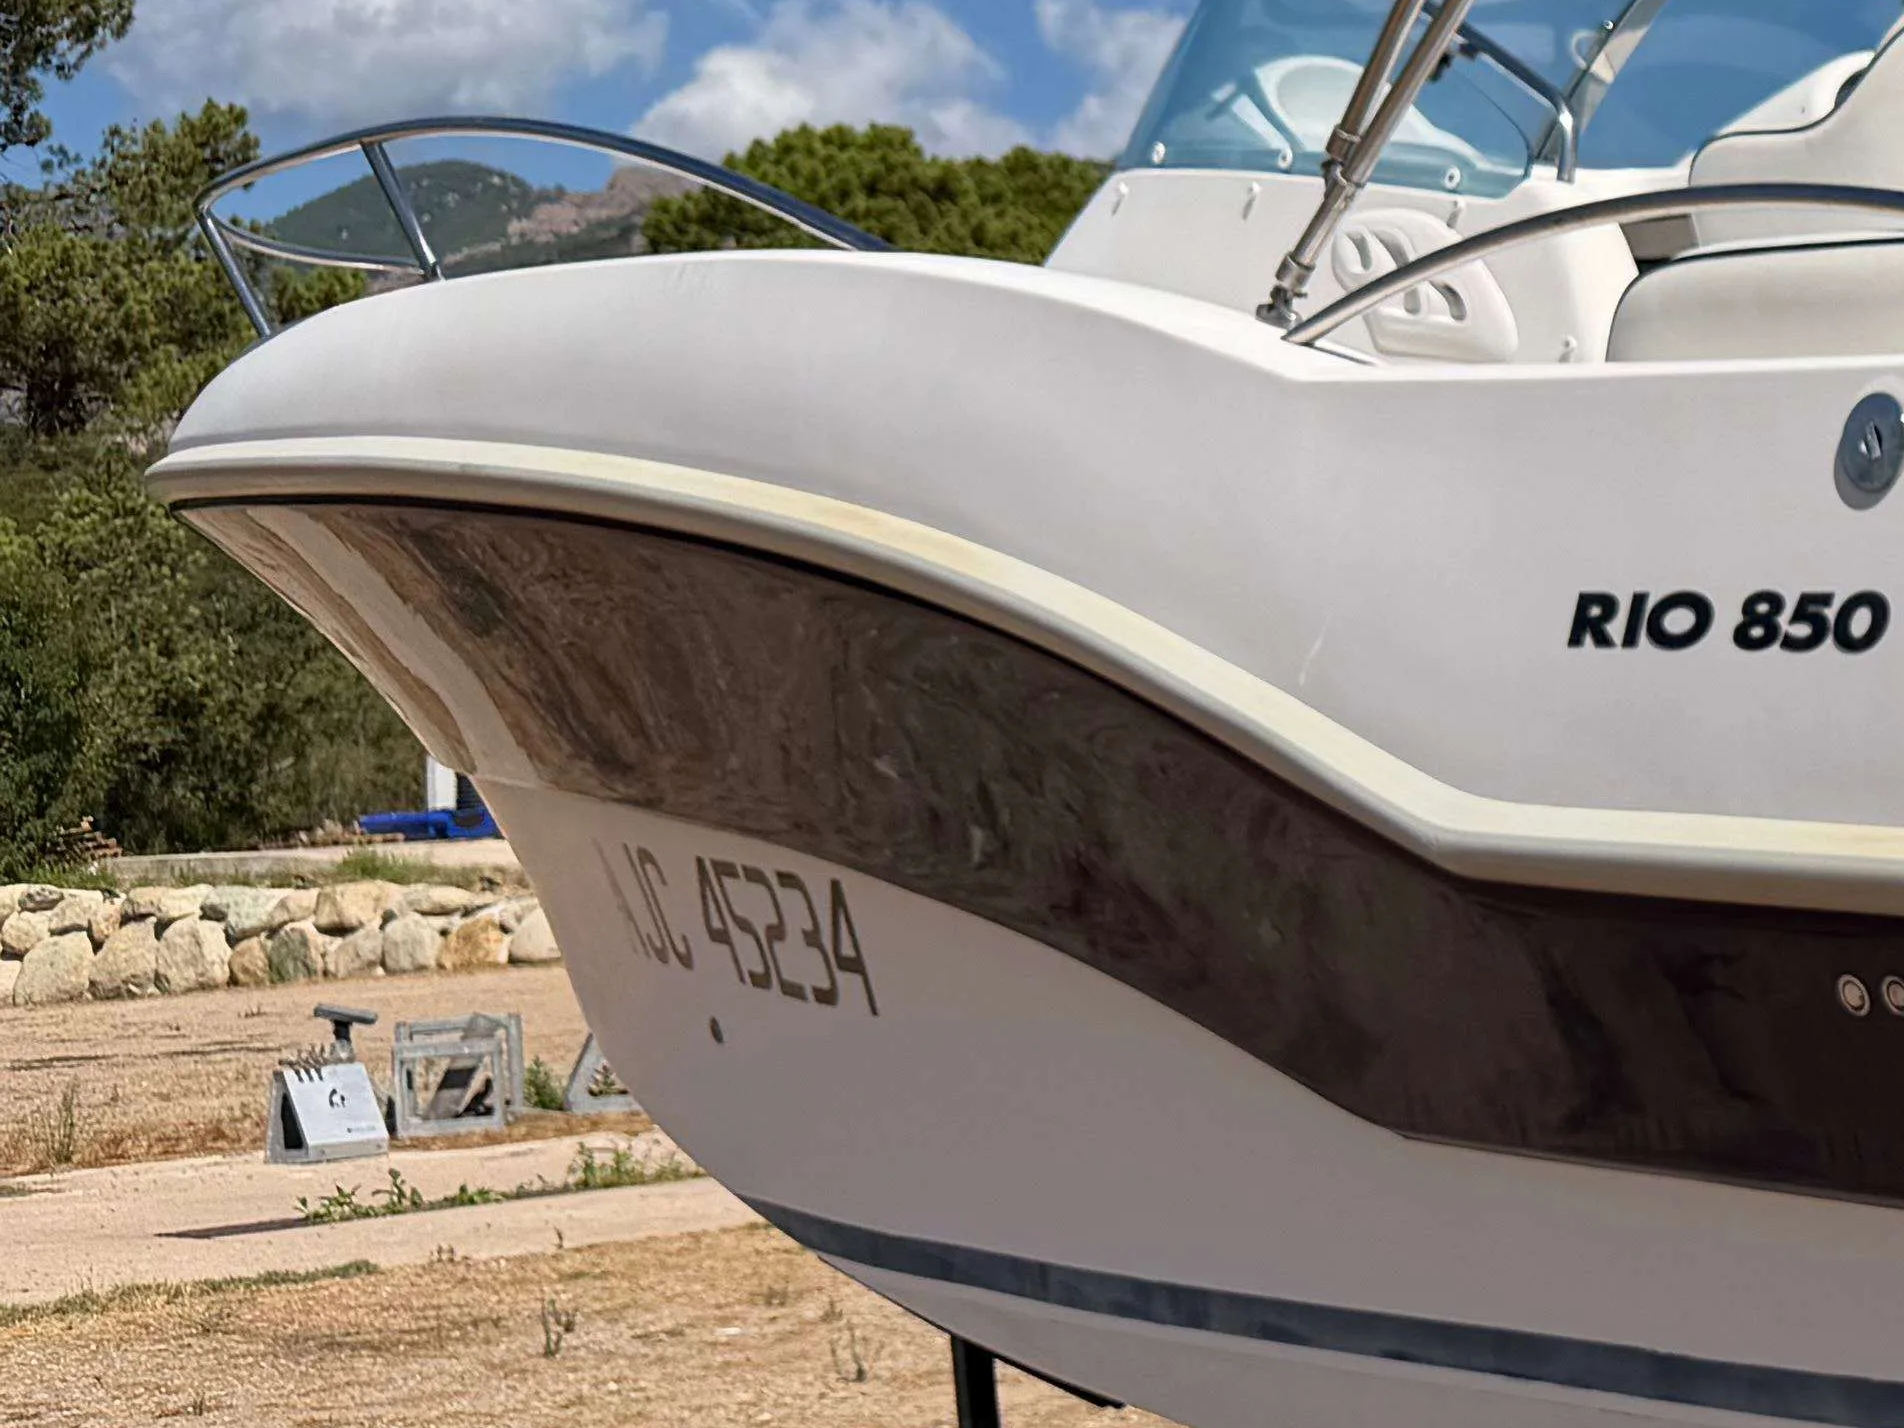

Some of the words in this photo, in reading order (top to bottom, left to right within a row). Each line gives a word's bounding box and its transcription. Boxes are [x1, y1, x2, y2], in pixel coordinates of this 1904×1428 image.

[1566, 589, 1715, 653] RIO
[1732, 588, 1892, 656] 850
[695, 855, 880, 1017] 45234
